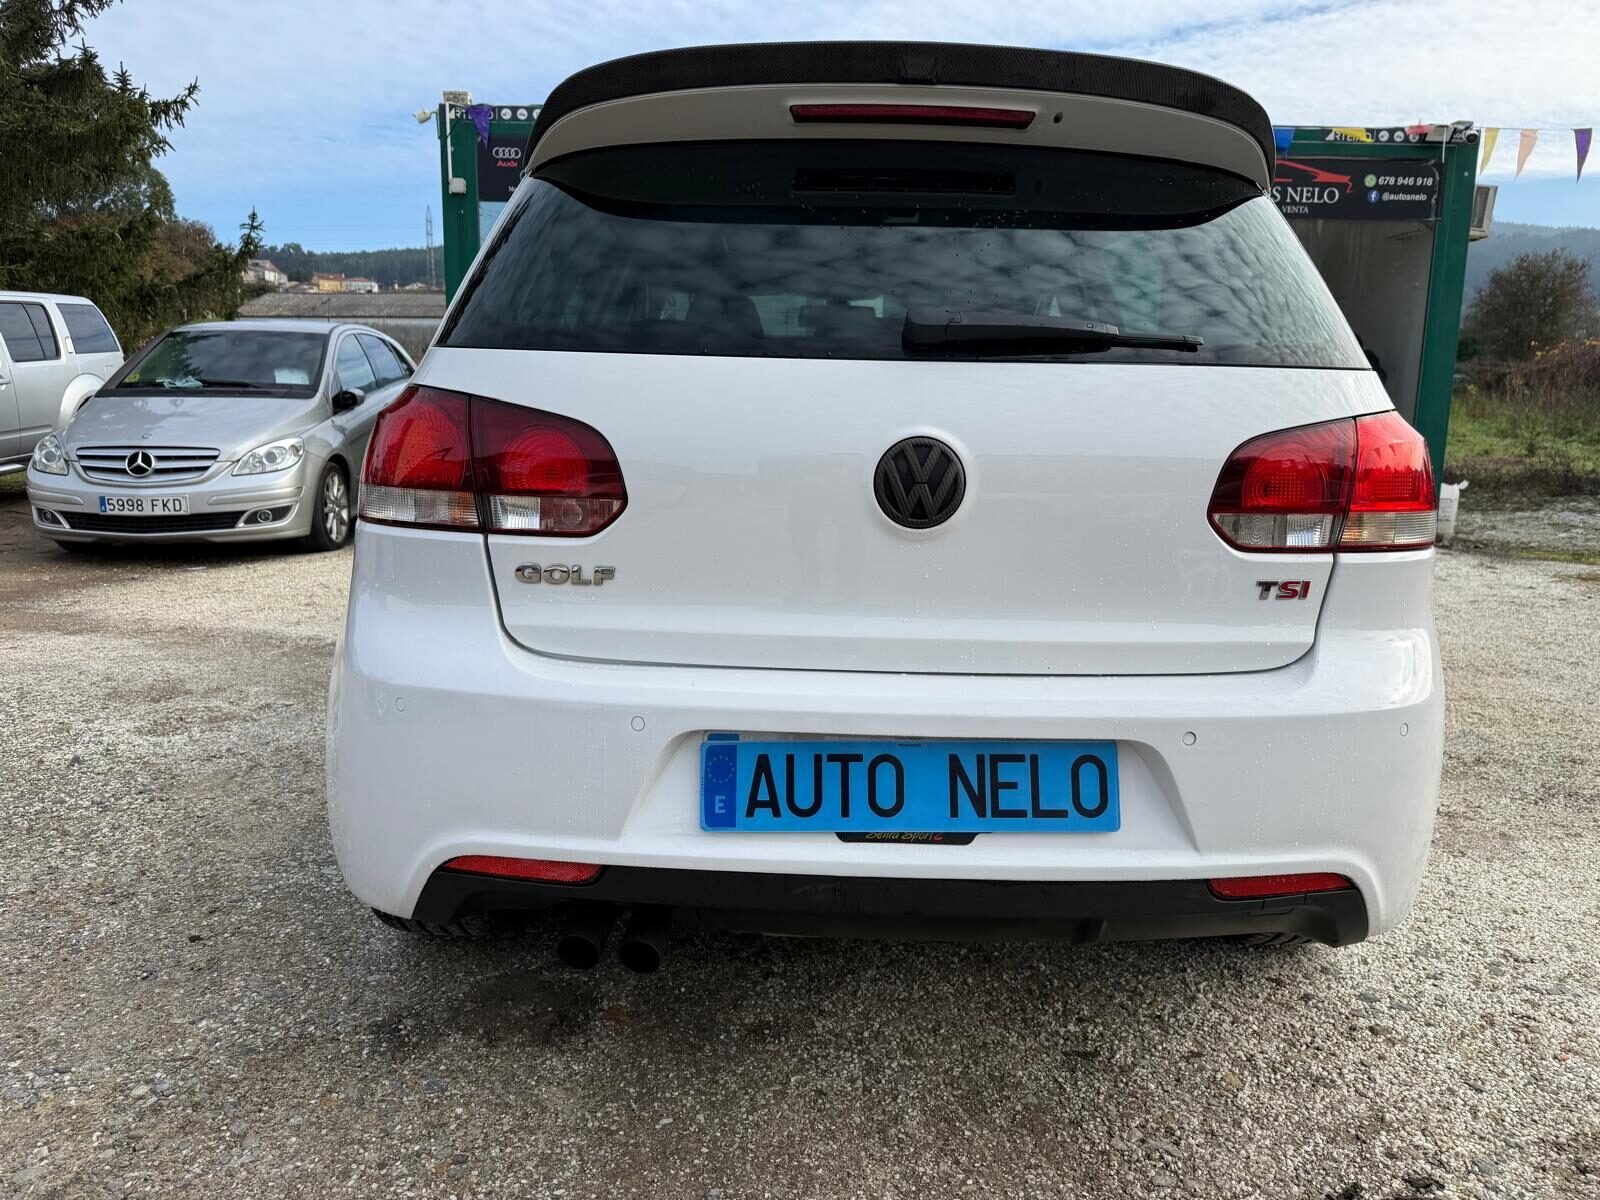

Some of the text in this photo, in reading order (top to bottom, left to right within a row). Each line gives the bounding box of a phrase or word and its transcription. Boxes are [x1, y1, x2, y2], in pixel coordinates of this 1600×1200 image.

[496, 160, 518, 168] Audi
[1378, 176, 1433, 186] 678 946 918
[1286, 186, 1339, 204] NELO
[1382, 191, 1427, 202] @autosnelo
[1282, 205, 1309, 214] VENTA
[106, 498, 144, 512] 5998
[151, 499, 182, 512] FKD
[514, 562, 616, 586] GOLF
[1256, 579, 1312, 600] TSI
[745, 753, 1109, 819] AUTO NELO
[714, 795, 726, 814] E
